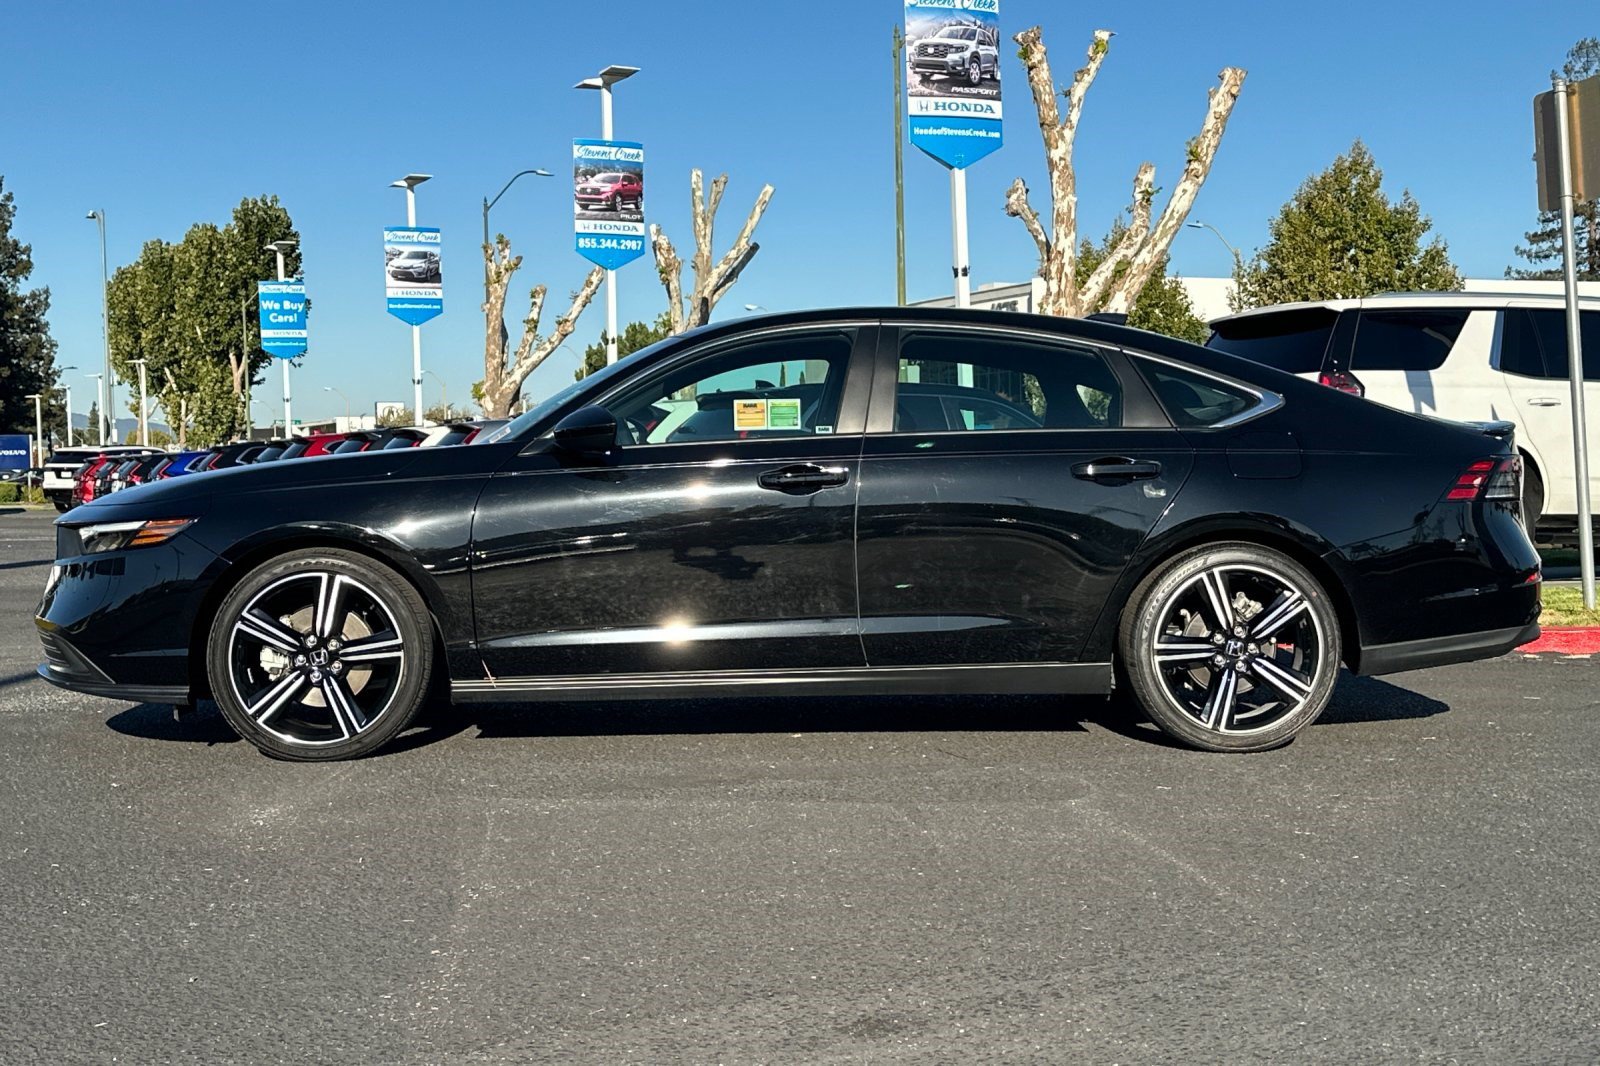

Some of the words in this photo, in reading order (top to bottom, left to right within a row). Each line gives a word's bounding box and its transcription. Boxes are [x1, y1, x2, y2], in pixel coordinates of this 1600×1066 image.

[951, 86, 998, 96] PASSPORT
[934, 102, 996, 114] HONDA
[576, 145, 612, 160] Stevens
[614, 147, 642, 161] Creek
[593, 223, 639, 232] HONDA
[578, 238, 642, 251] 855.344.2987
[261, 300, 281, 310] We
[283, 300, 305, 312] Buy
[269, 313, 298, 323] Cars!
